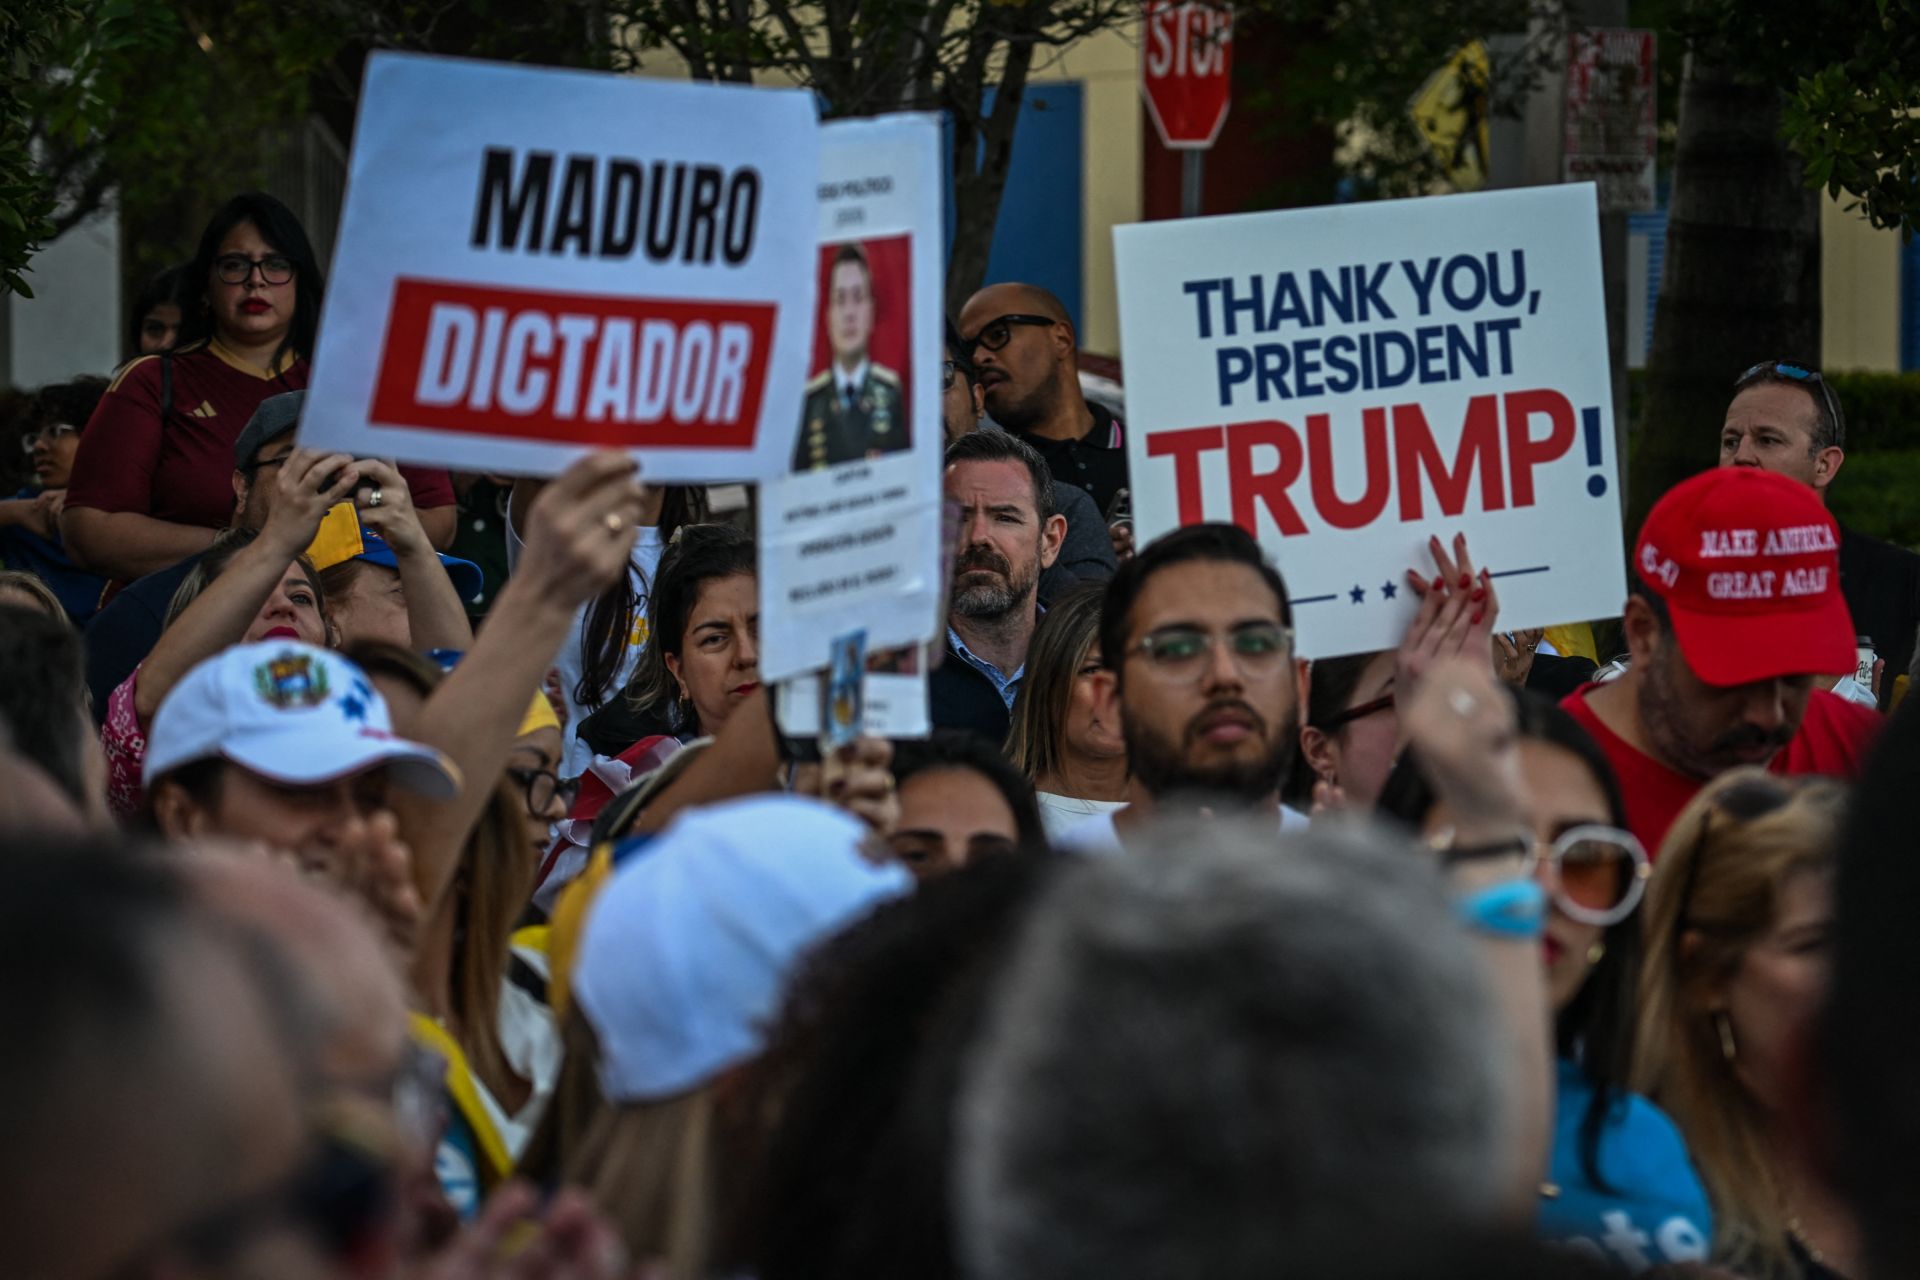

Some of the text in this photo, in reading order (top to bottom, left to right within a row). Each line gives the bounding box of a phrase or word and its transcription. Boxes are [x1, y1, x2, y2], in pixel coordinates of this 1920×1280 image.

[1149, 2, 1233, 78] STOP
[470, 146, 761, 268] MADURO
[1183, 249, 1541, 338] THANK YOU,
[415, 302, 753, 425] DICTADOR
[1216, 317, 1521, 406] PRESIDENT
[1146, 388, 1607, 538] TRUMP!
[1699, 524, 1836, 557] MAKE AMERICA
[1707, 570, 1776, 599] GREAT
